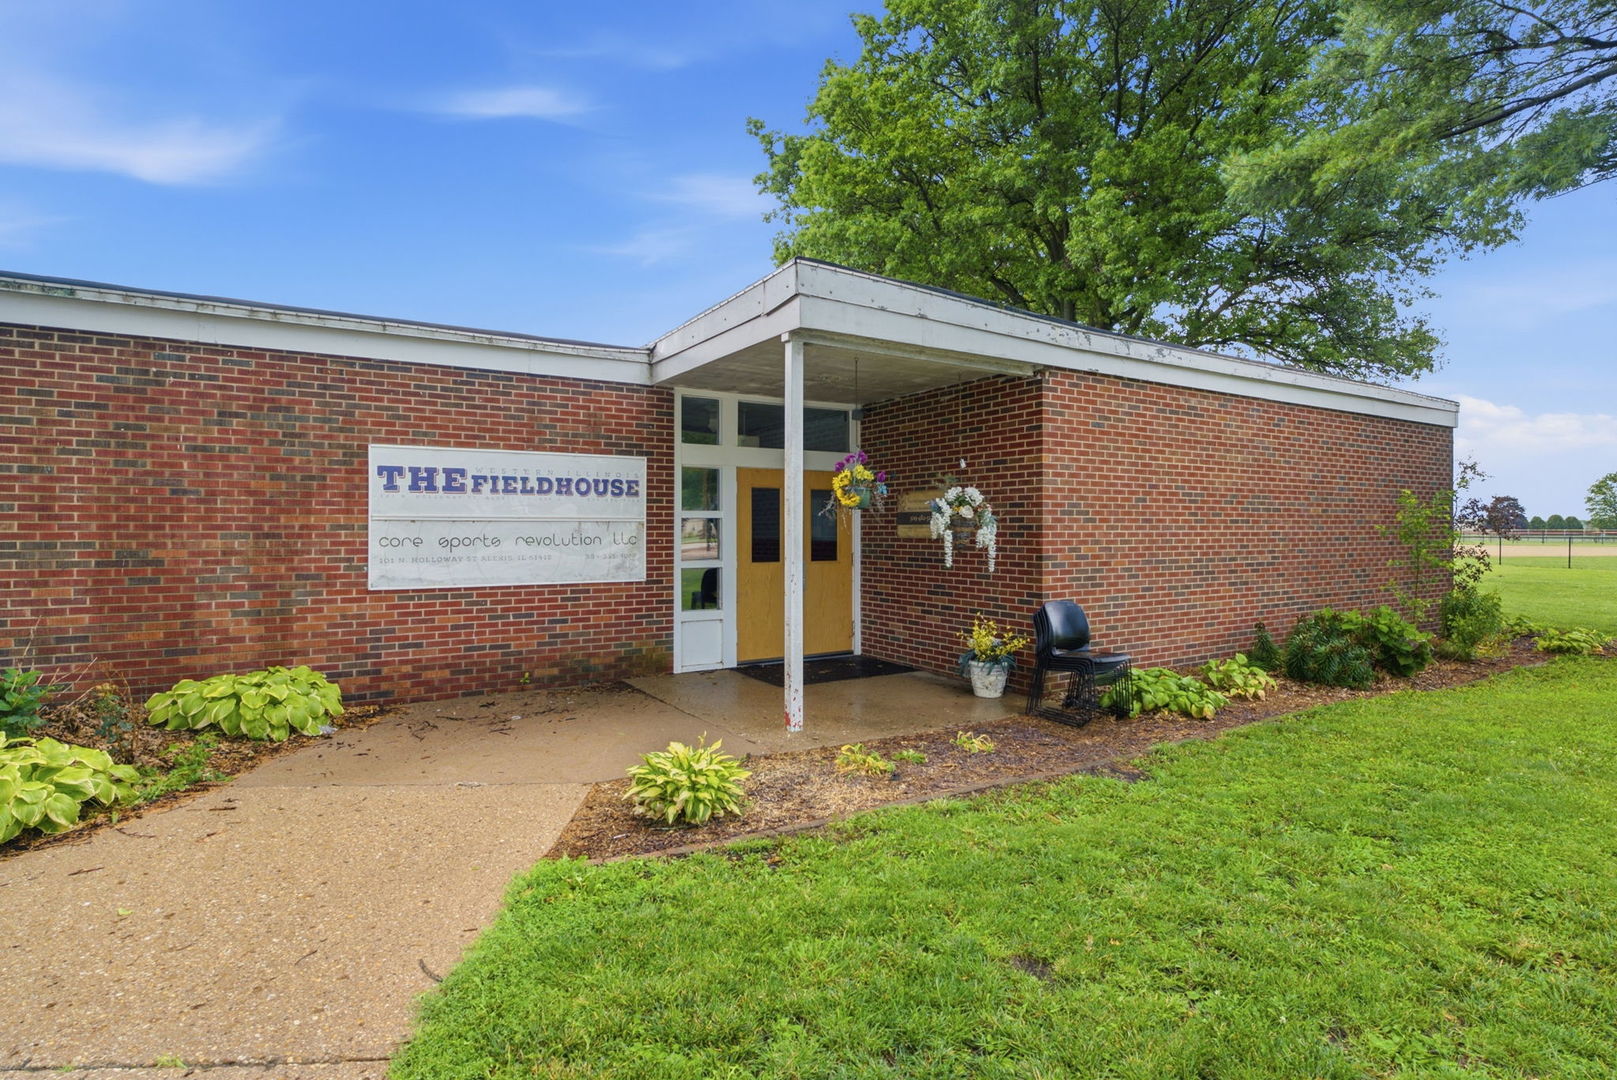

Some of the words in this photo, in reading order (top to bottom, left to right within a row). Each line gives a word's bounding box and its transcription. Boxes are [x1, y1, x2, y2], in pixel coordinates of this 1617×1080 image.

[376, 465, 468, 494] THE
[471, 474, 641, 498] FIELDHOUSE
[475, 466, 554, 476] WESTERN
[567, 469, 640, 479] ILLINOIS
[378, 535, 424, 548] core
[438, 533, 501, 553] sports
[515, 532, 602, 547] revolution
[613, 532, 637, 546] llc
